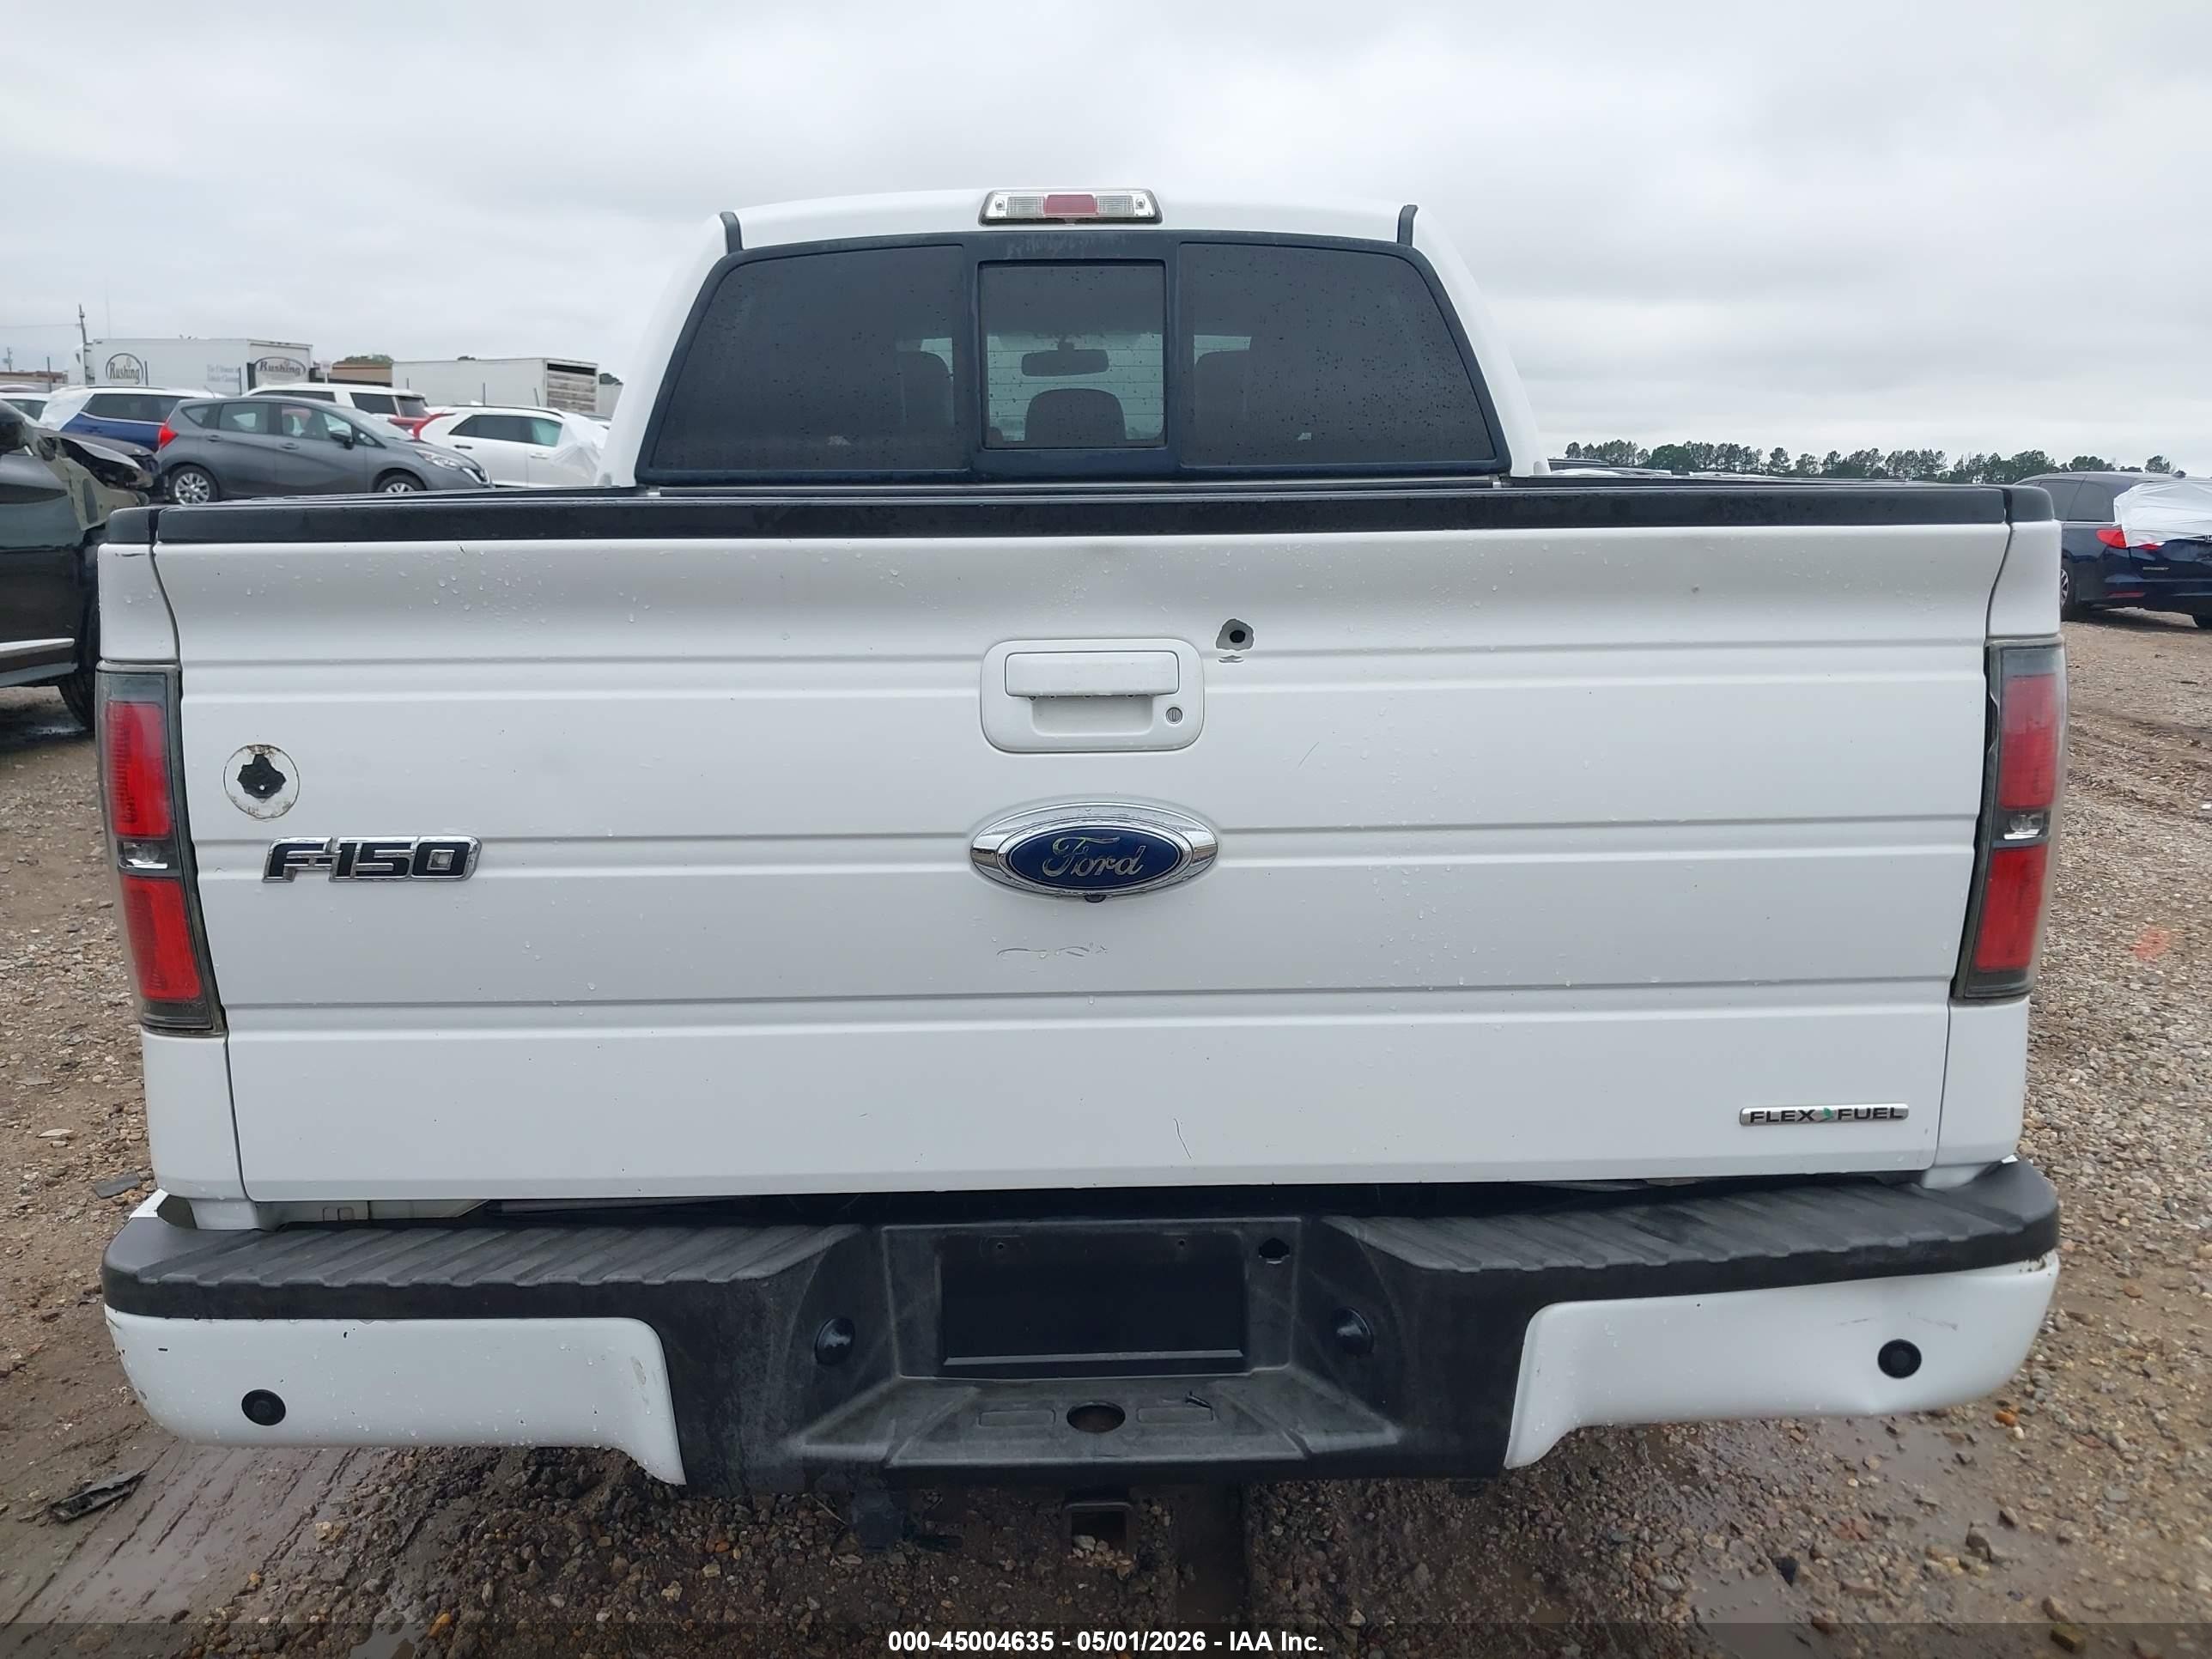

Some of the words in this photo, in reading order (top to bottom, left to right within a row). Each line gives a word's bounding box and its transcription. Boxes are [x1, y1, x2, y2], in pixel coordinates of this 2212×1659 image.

[110, 362, 140, 385] Rushing
[260, 361, 301, 377] Rushing
[262, 836, 482, 883] F-150
[1042, 836, 1146, 878] Ford
[1749, 1109, 1816, 1124] FLEX
[1838, 1107, 1905, 1121] FUEL
